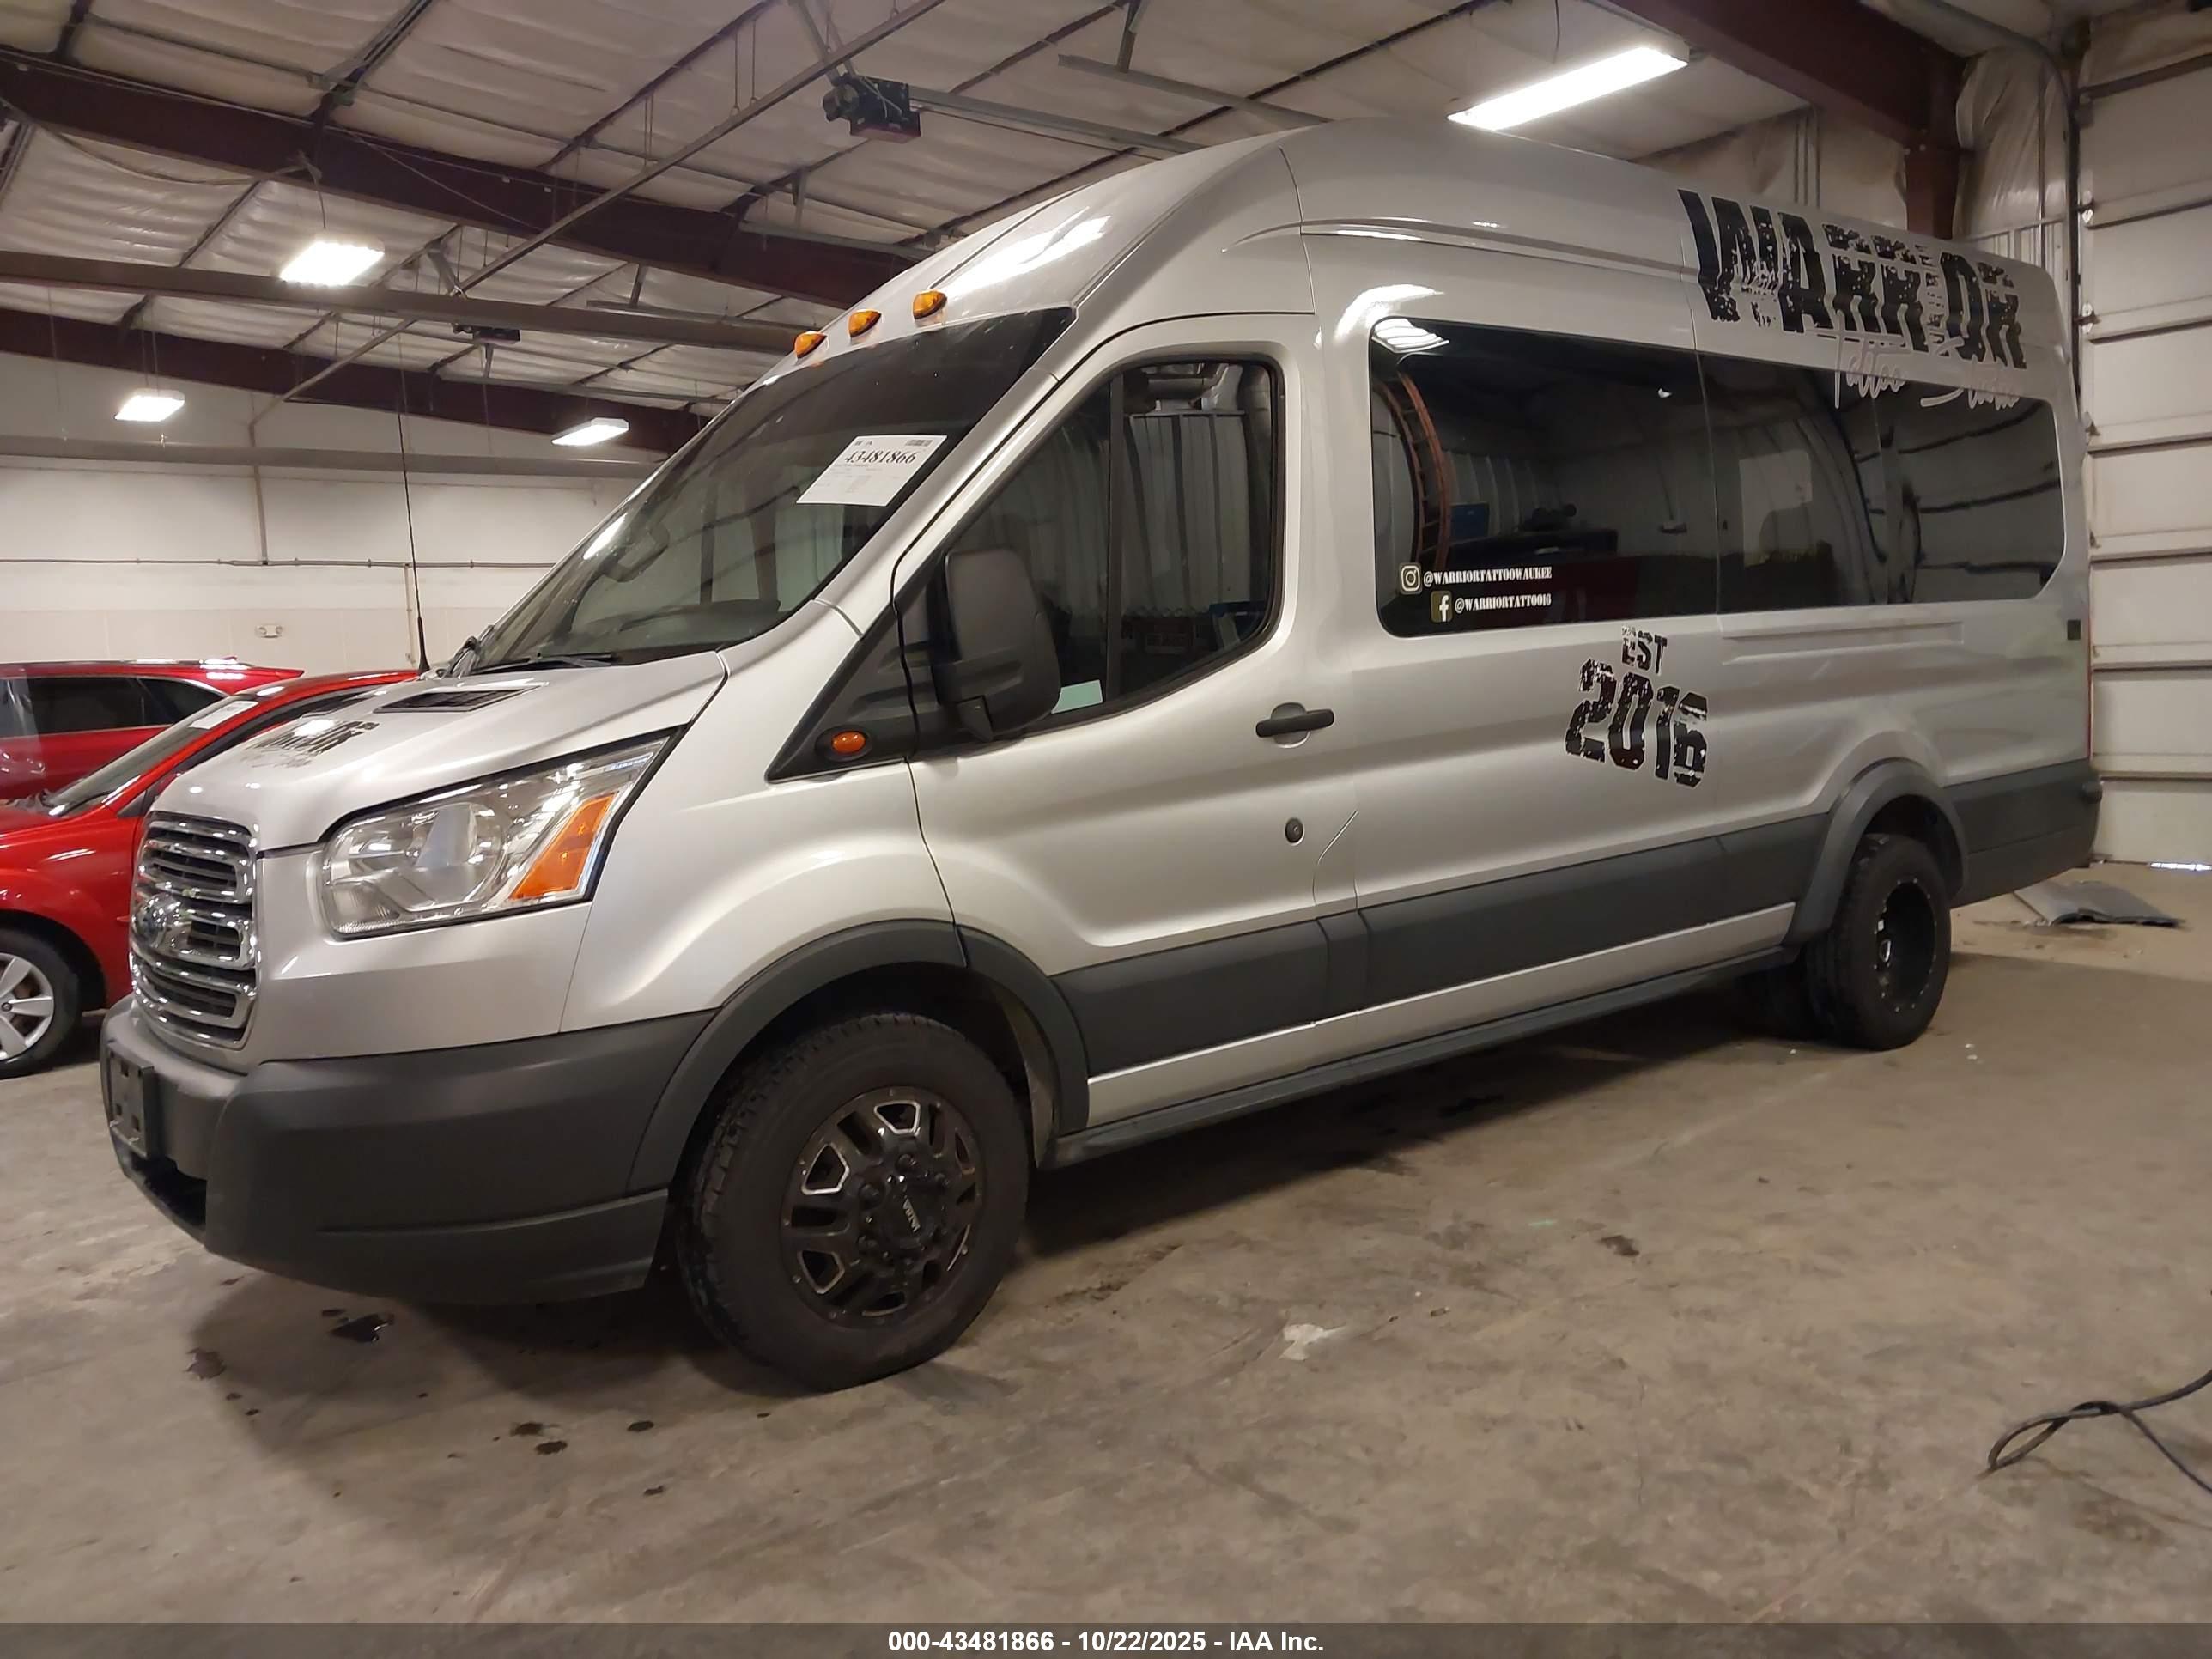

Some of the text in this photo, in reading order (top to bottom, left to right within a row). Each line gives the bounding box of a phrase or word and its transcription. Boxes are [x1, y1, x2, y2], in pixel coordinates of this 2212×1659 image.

[845, 450, 918, 465] 43481866
[1423, 566, 1553, 588] @WARRIORTATTOOWAUKEE
[1621, 625, 1668, 676] EST
[1565, 659, 1709, 788] 2016
